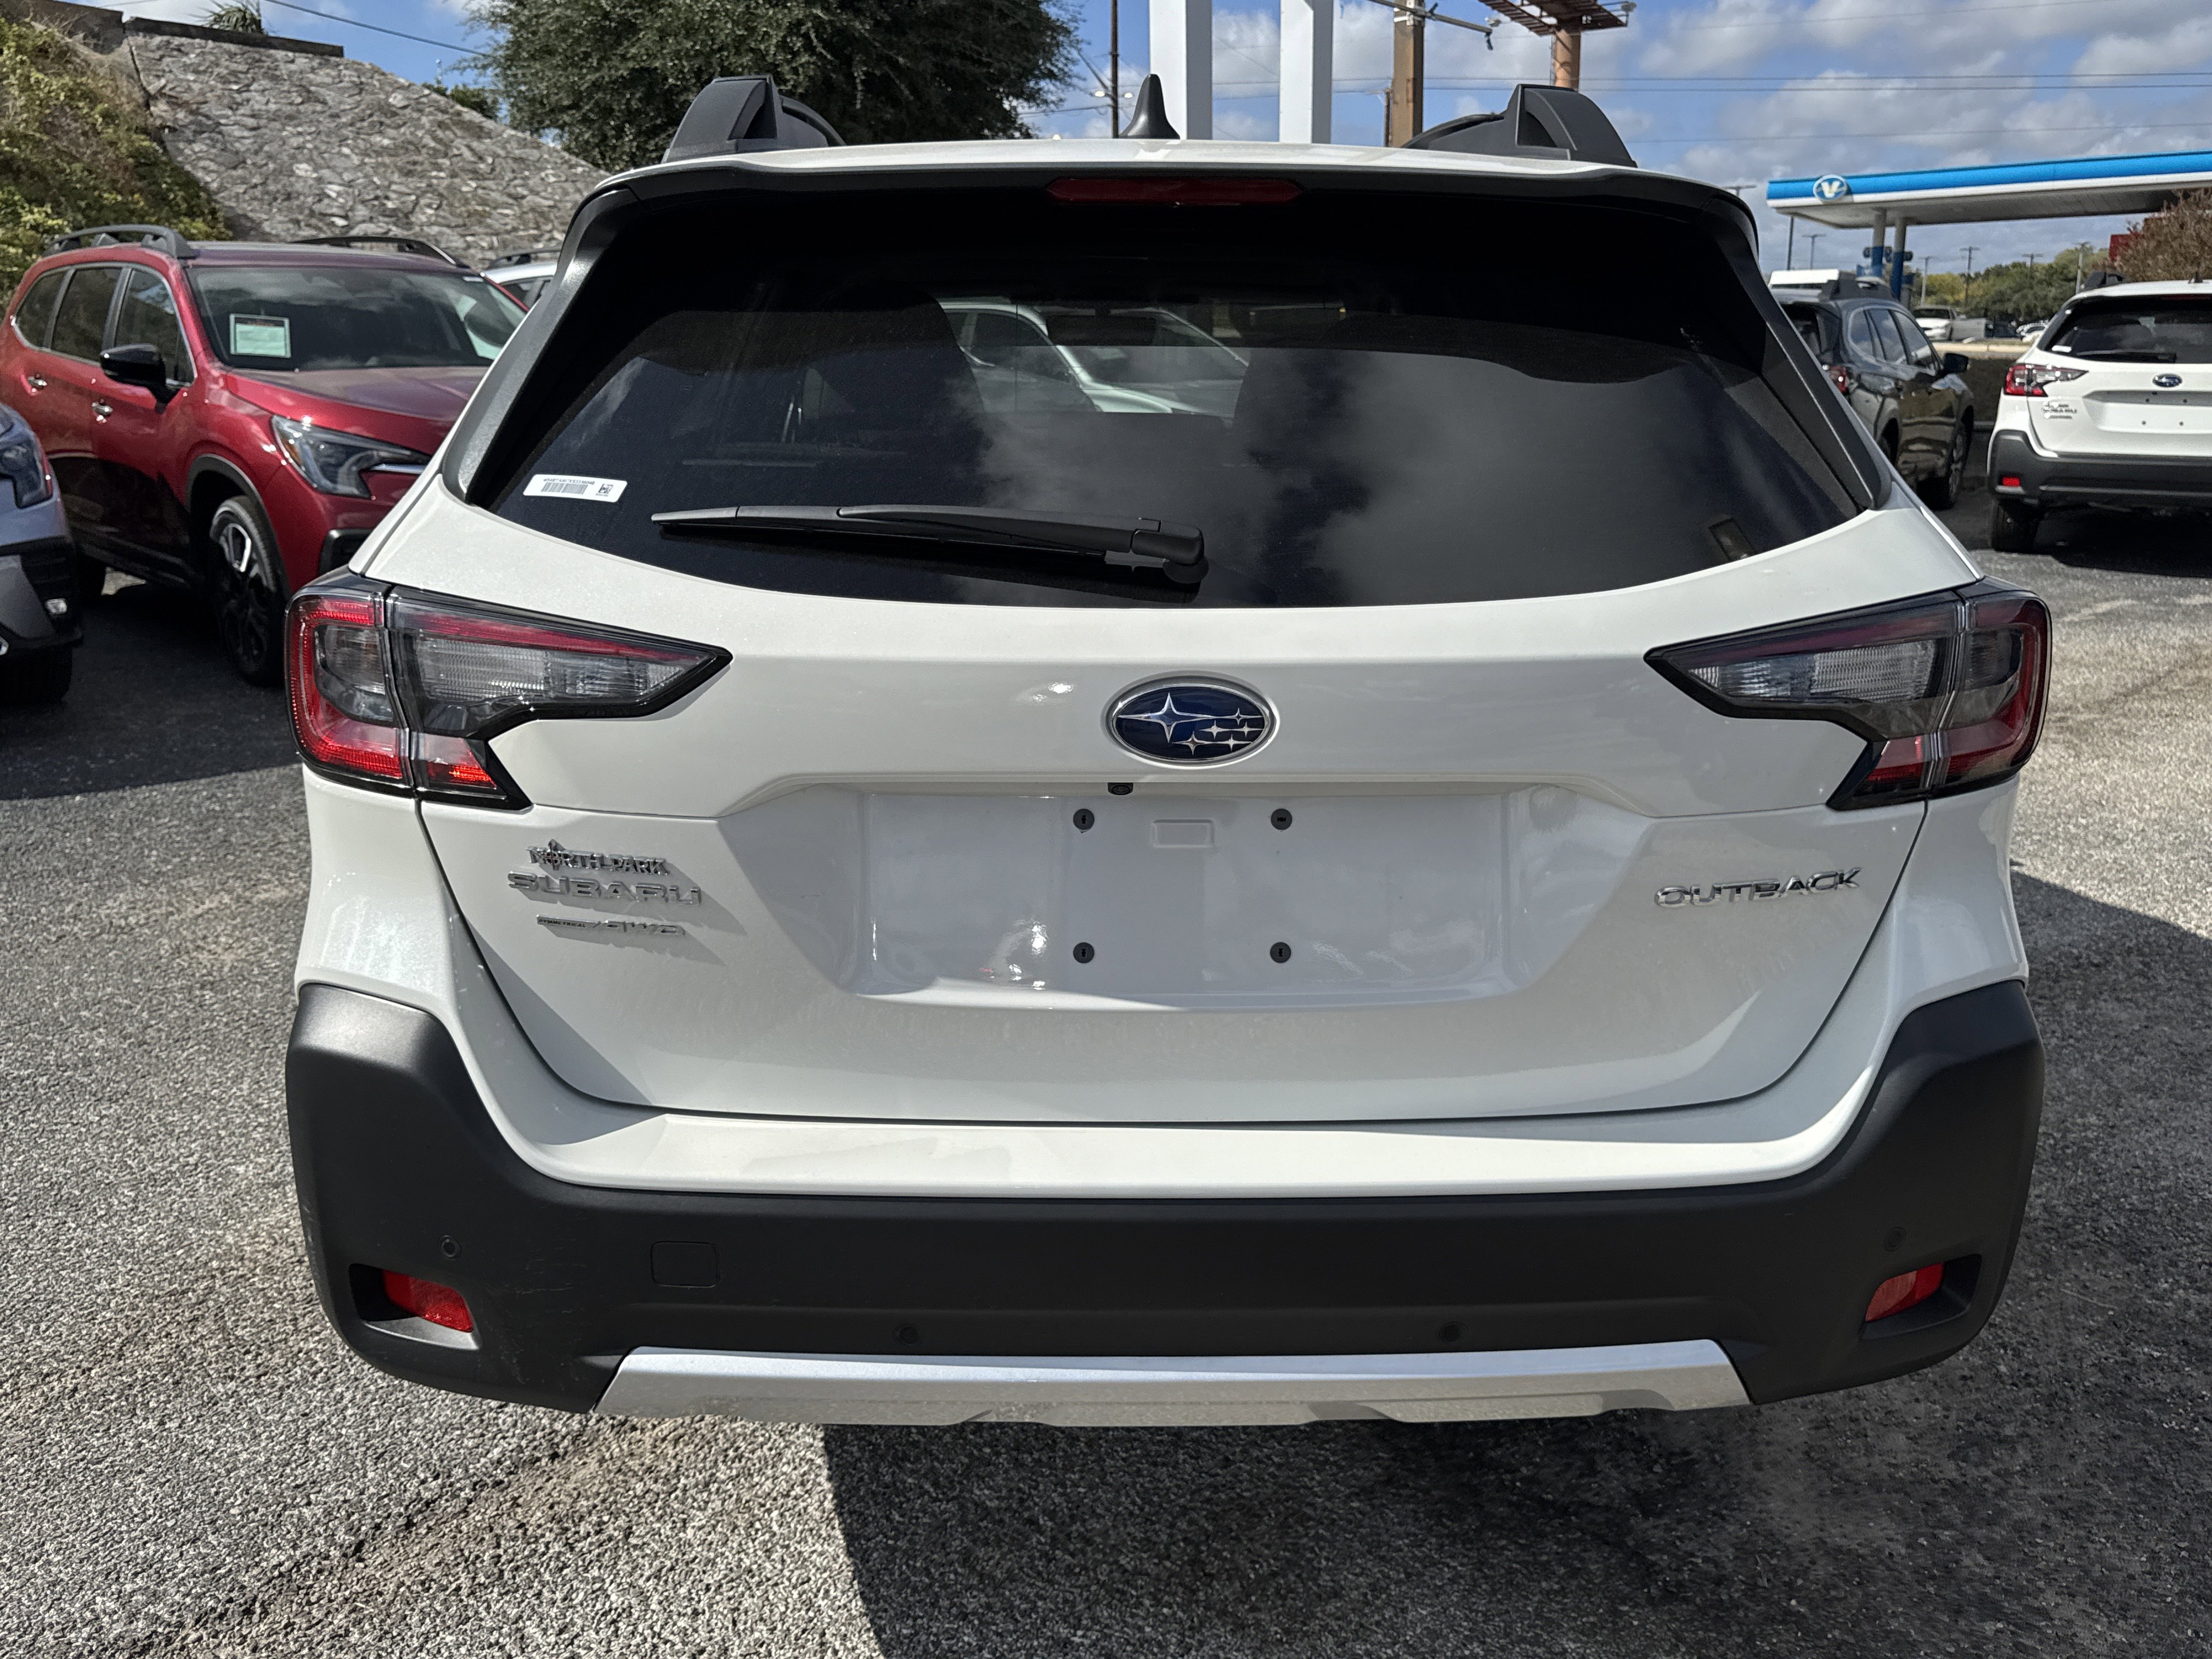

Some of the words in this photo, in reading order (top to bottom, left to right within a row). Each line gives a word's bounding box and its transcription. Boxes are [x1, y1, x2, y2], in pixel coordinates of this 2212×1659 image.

[527, 842, 604, 871] NORTH
[607, 854, 670, 876] PARK
[507, 871, 702, 905] SUBARU
[1654, 867, 1861, 908] OUTBACK
[592, 920, 686, 937] AWD
